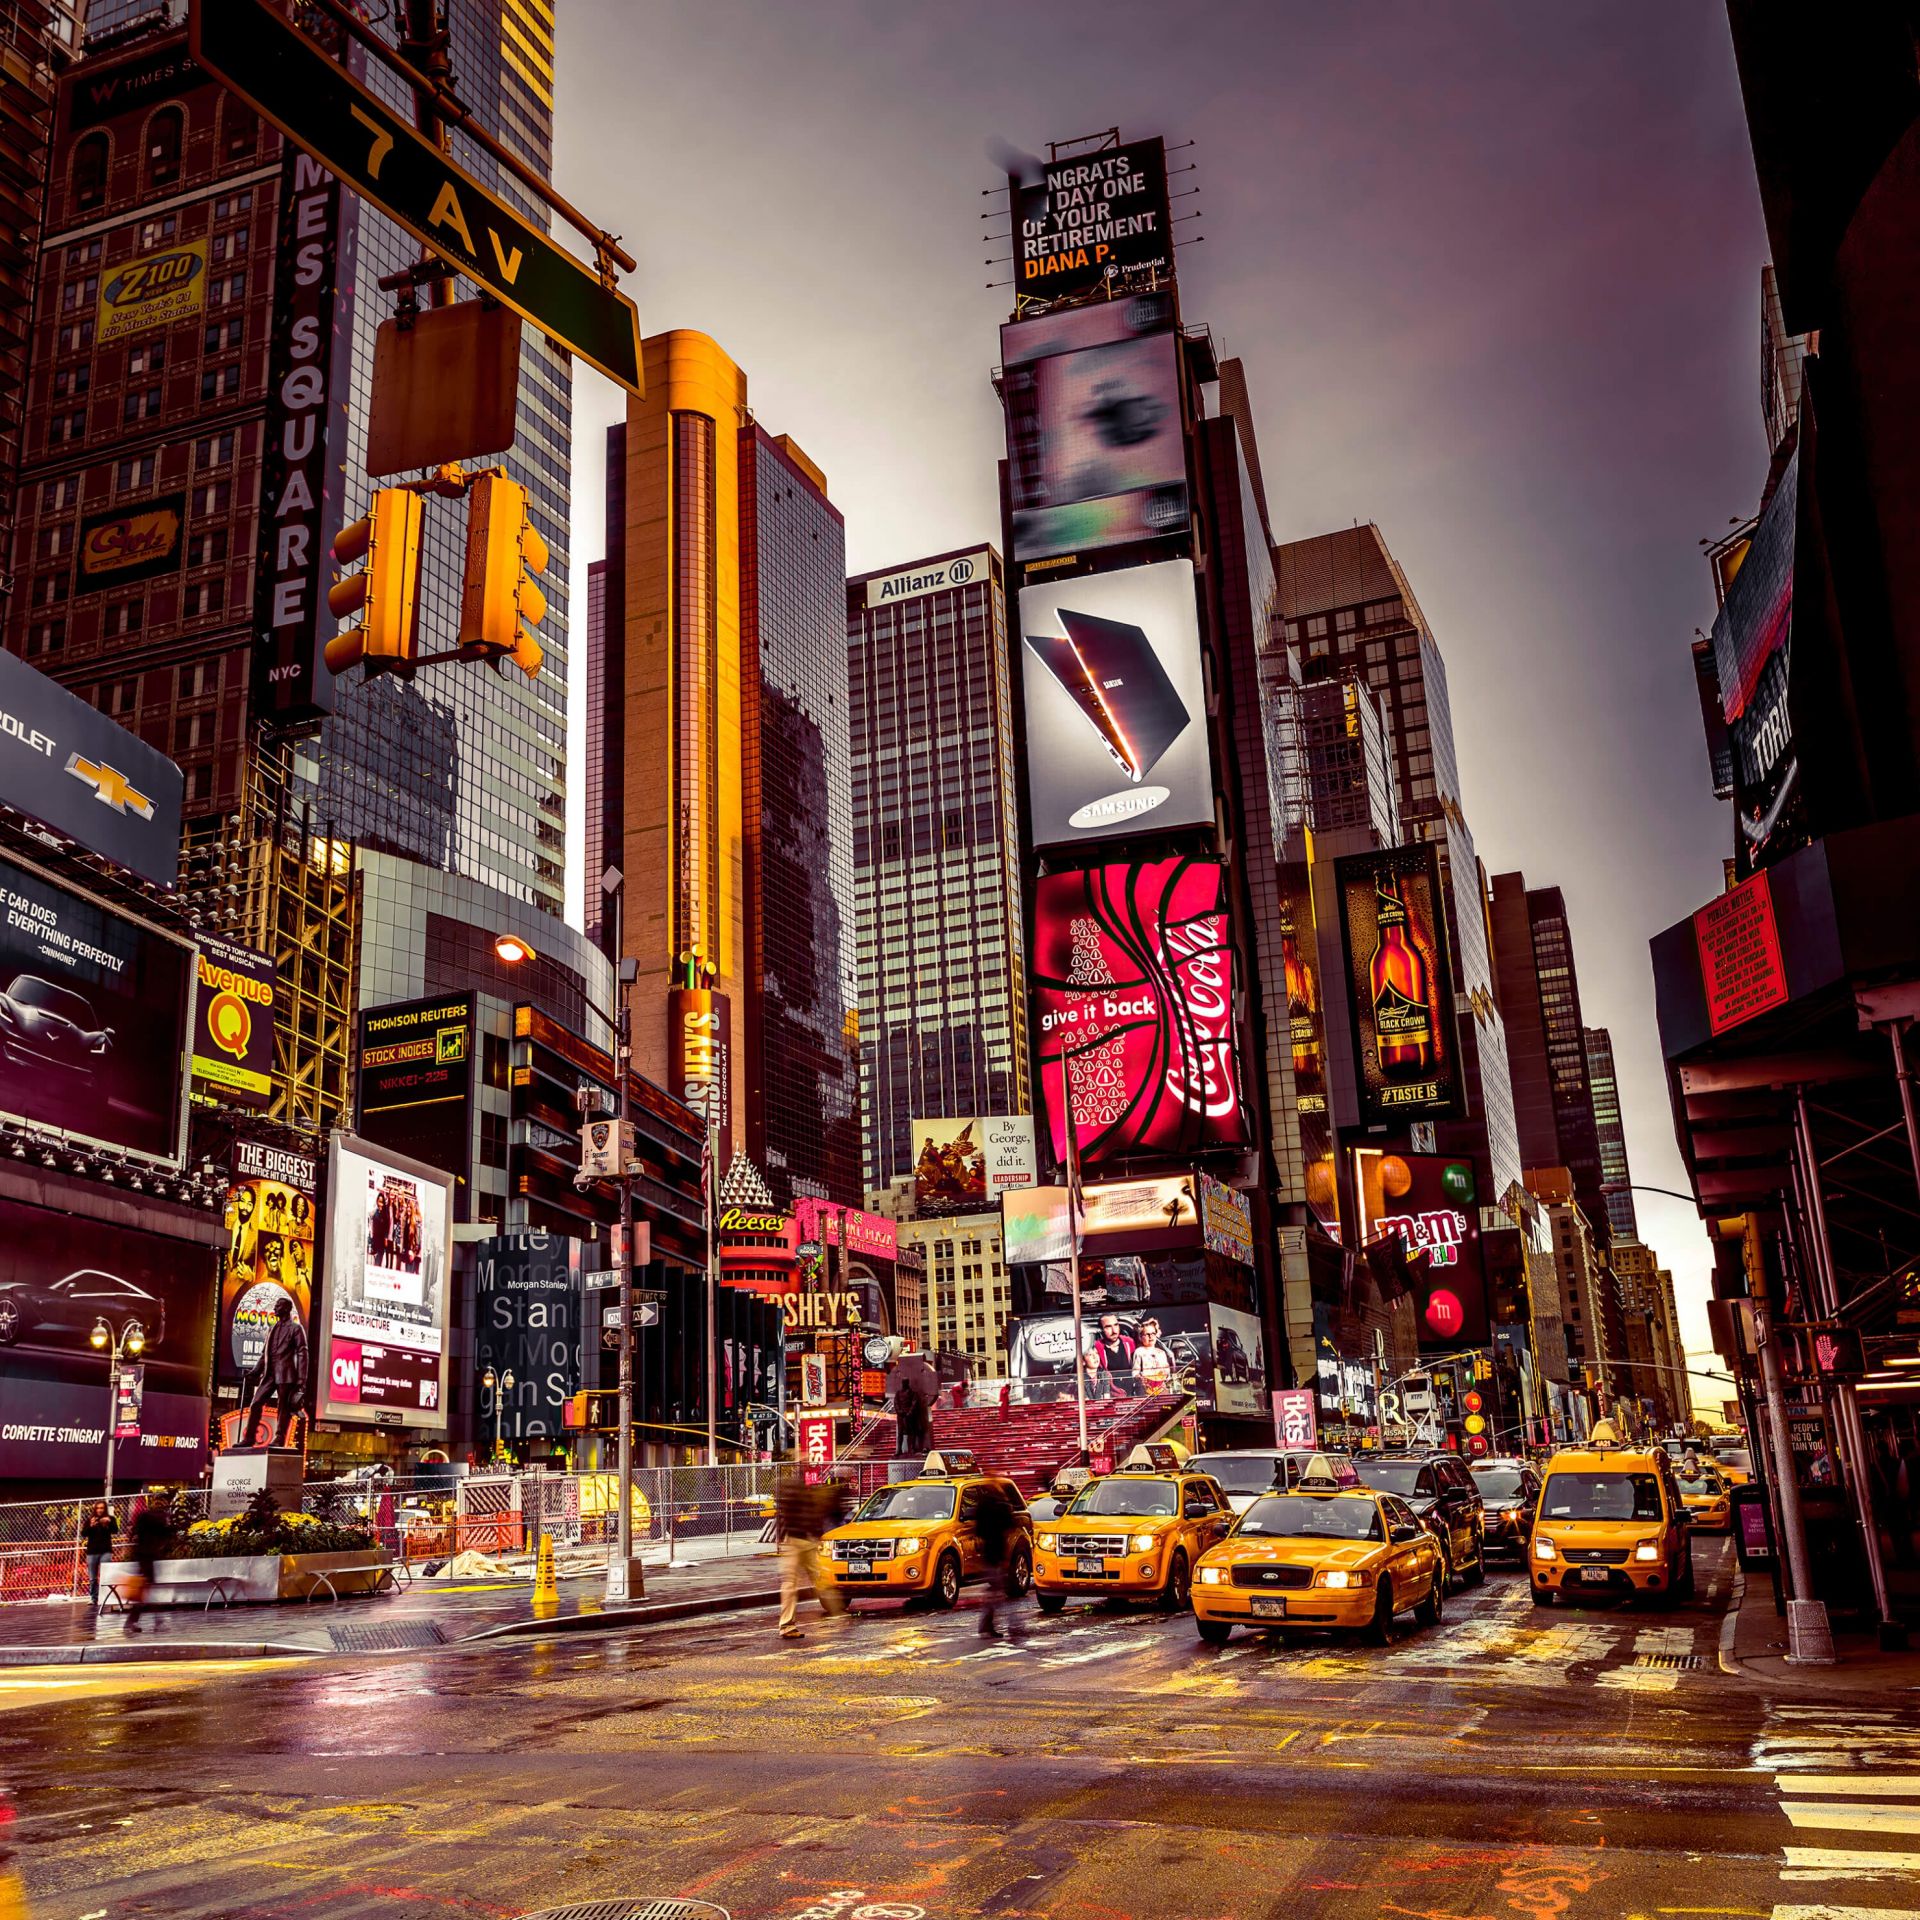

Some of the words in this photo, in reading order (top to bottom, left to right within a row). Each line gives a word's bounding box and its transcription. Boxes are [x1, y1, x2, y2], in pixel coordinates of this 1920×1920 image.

[125, 66, 175, 93] TIMES
[350, 102, 394, 181] 7
[1057, 183, 1100, 211] DAY
[1104, 173, 1146, 199] ONE
[1053, 202, 1111, 231] YOUR
[1024, 212, 1158, 259] RETIREMENT,
[1025, 250, 1090, 280] DIANA
[1095, 244, 1116, 264] P.
[1121, 257, 1166, 275] Prudential
[113, 253, 193, 306] Z100
[111, 310, 138, 325] New
[141, 299, 174, 316] York's
[176, 291, 192, 304] #1
[101, 327, 121, 340] Hit
[121, 315, 158, 333] Music
[159, 304, 200, 321] Station
[272, 316, 326, 628] SQUARE
[880, 571, 945, 600] Allianz
[269, 663, 302, 683] NYC
[1103, 678, 1124, 690] SAMSUNG
[1081, 796, 1158, 818] SAMSUNG
[8, 892, 30, 917] CAR
[30, 898, 57, 927] DOES
[7, 912, 71, 950] EVERYTHING
[71, 940, 124, 972] PERFECTLY
[212, 948, 228, 960] BEST
[228, 953, 256, 969] MUSICAL
[198, 954, 273, 1006] Avenue
[367, 1011, 418, 1033] THOMSON
[420, 1004, 467, 1023] REUTERS
[1042, 1009, 1078, 1031] give
[1084, 1004, 1096, 1020] it
[1103, 996, 1156, 1018] back
[1380, 1017, 1400, 1029] BLACK
[1400, 1015, 1425, 1027] CROWN
[207, 991, 252, 1061] Q
[364, 1047, 396, 1065] STOCK
[398, 1043, 433, 1060] INDICES
[379, 1069, 449, 1090] NIKKEI-225
[1426, 1084, 1438, 1098] IS
[1003, 1121, 1015, 1134] By
[990, 1133, 1030, 1145] George,
[1003, 1146, 1018, 1154] we
[265, 1150, 315, 1180] BIGGEST
[996, 1155, 1013, 1167] did
[1015, 1155, 1026, 1166] it.
[238, 1162, 250, 1174] BOX
[250, 1164, 270, 1179] OFFICE
[270, 1169, 280, 1182] HIT
[280, 1172, 288, 1183] OF
[288, 1174, 299, 1186] THE
[993, 1174, 1029, 1183] LEADERSHIP
[719, 1208, 786, 1231] Reese's
[507, 1280, 540, 1291] Morgan
[540, 1280, 568, 1292] Stanley
[594, 1275, 604, 1287] 46
[659, 1293, 667, 1301] SQ
[334, 1310, 347, 1323] SEE
[347, 1313, 366, 1327] YOUR
[366, 1316, 390, 1331] PICTURE
[1437, 1302, 1451, 1320] m
[243, 1340, 254, 1353] ON
[606, 1334, 617, 1343] ONE
[332, 1358, 360, 1387] CNN
[1282, 1394, 1305, 1444] tkts
[1379, 1393, 1412, 1425] R
[2, 1424, 56, 1442] CORVETTE
[57, 1427, 105, 1446] STINGRAY
[1792, 1422, 1821, 1432] PEOPLE
[1802, 1432, 1812, 1441] TO
[140, 1433, 158, 1447] FIND
[158, 1435, 175, 1448] NEW
[175, 1436, 199, 1449] ROADS
[808, 1422, 828, 1467] tkts
[1473, 1441, 1482, 1449] m
[1808, 1441, 1823, 1451] YOU
[227, 1478, 252, 1486] GEORGE
[1308, 1478, 1327, 1486] 9P32
